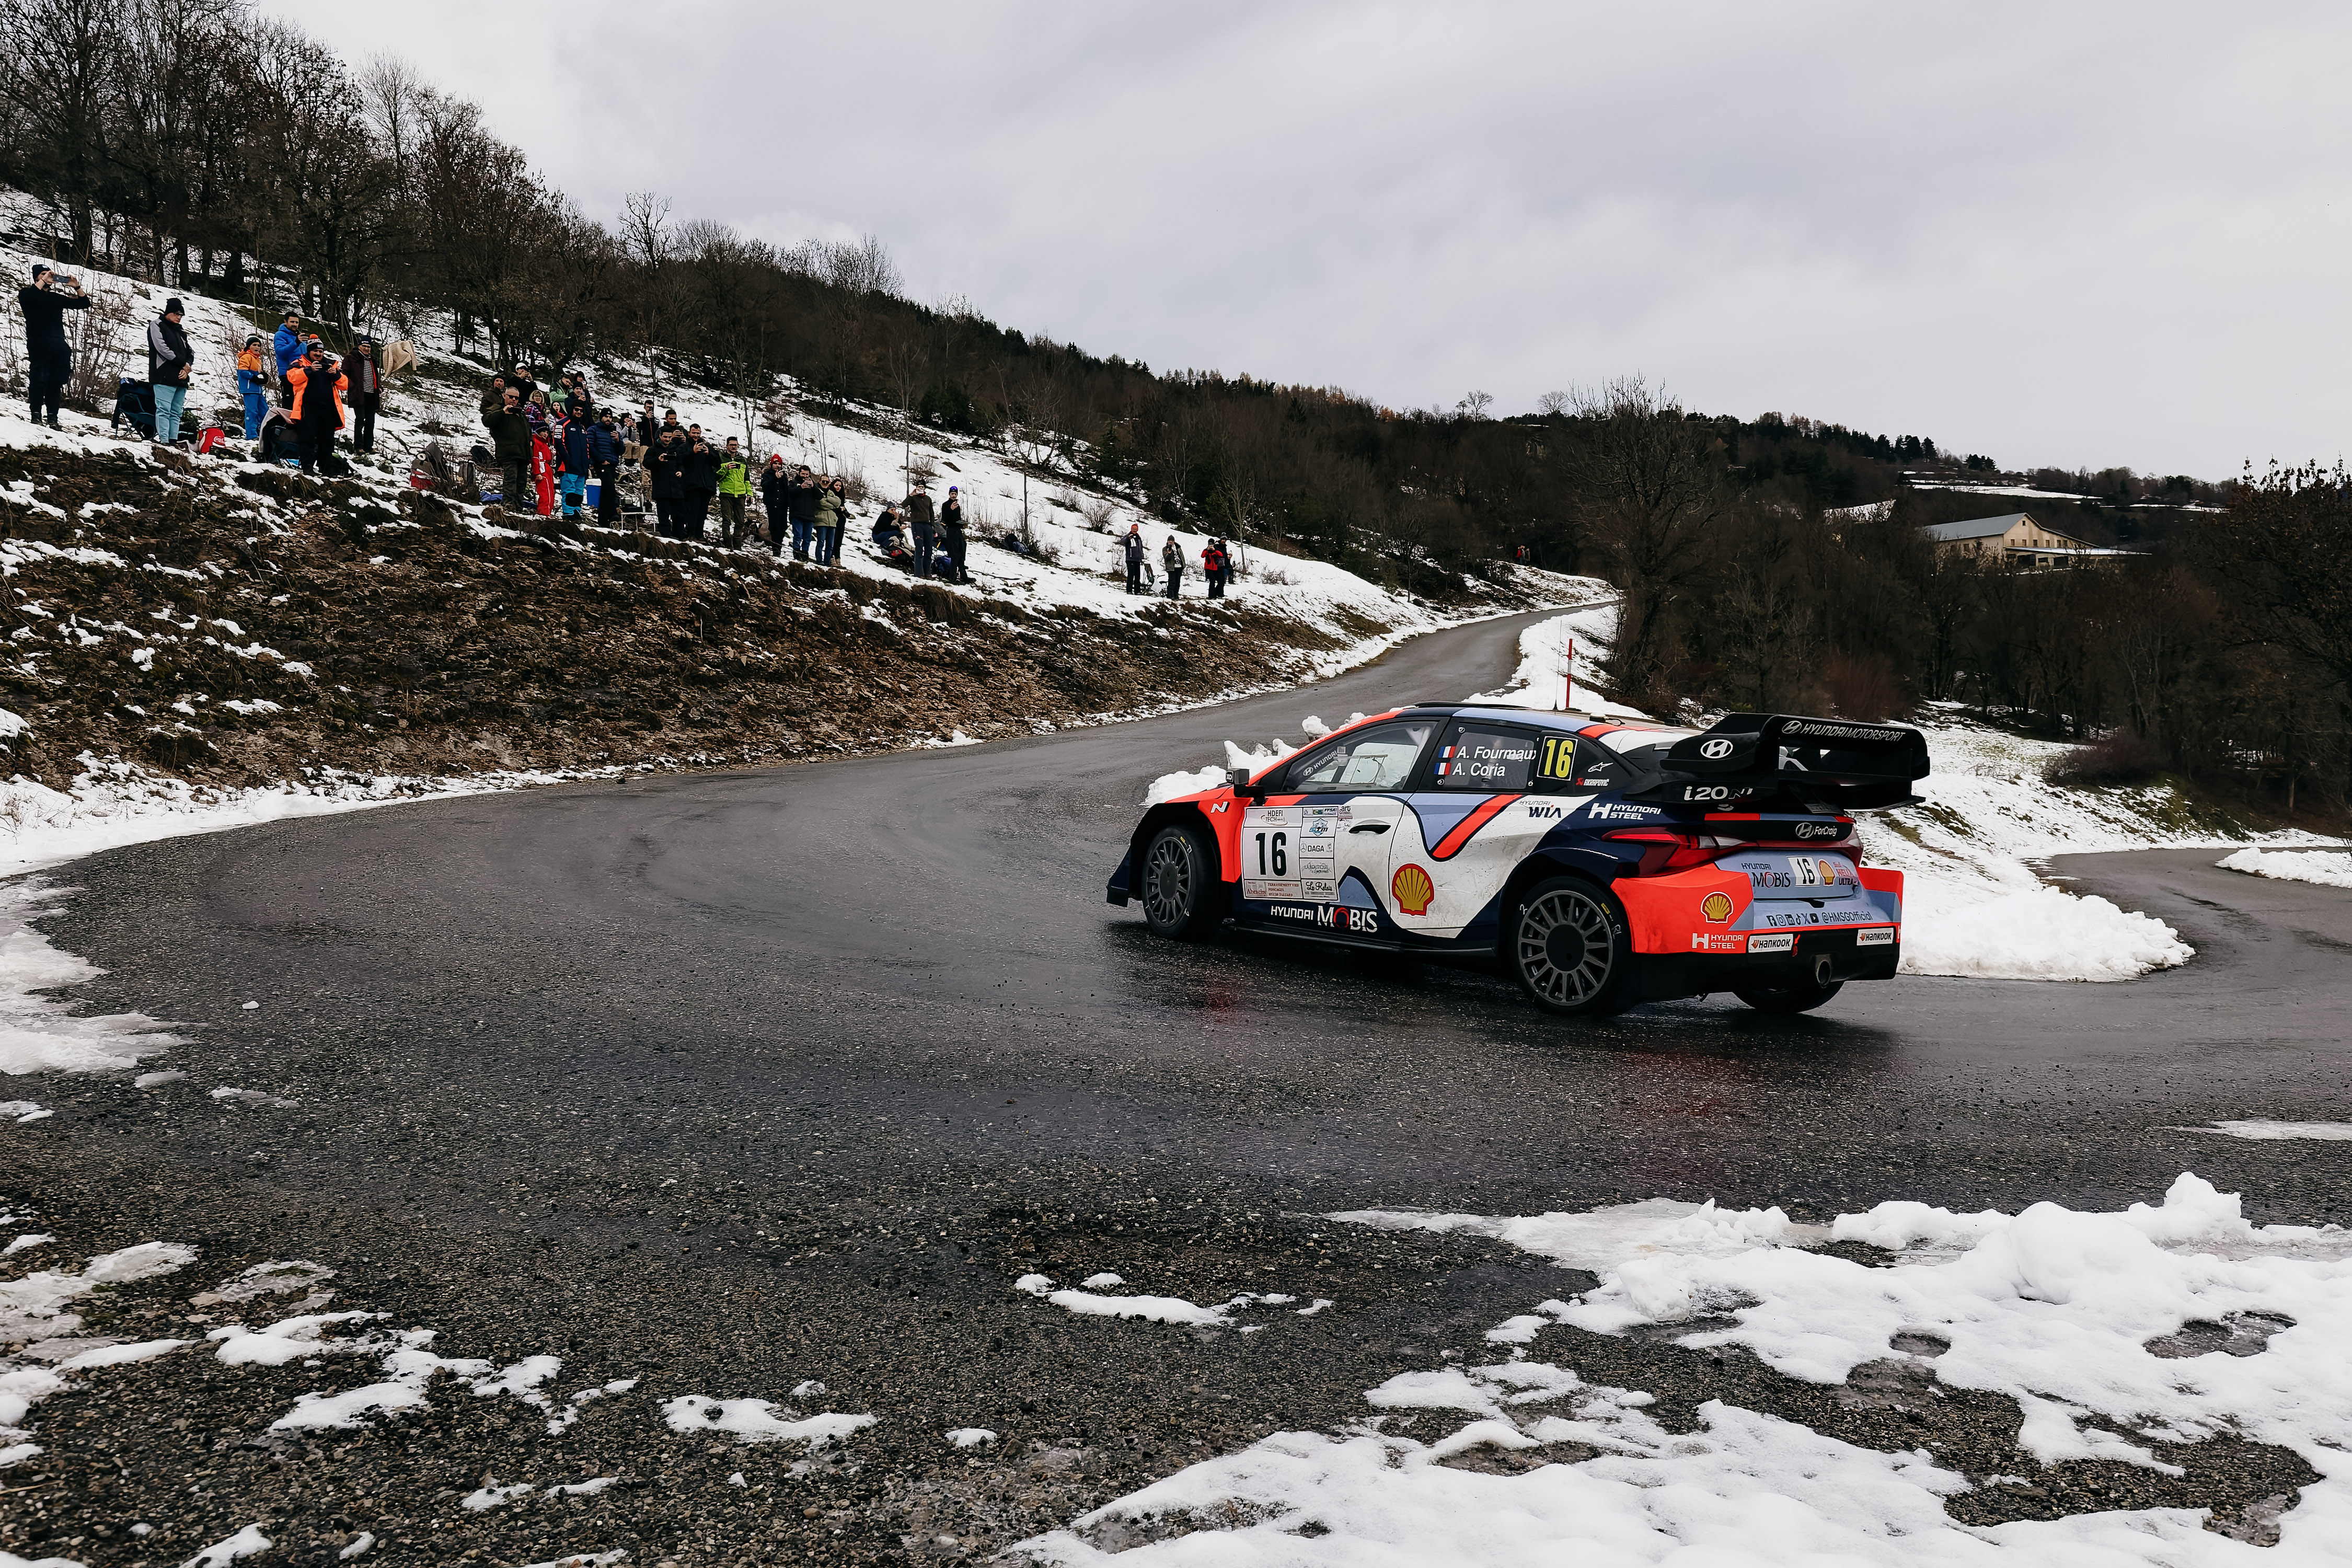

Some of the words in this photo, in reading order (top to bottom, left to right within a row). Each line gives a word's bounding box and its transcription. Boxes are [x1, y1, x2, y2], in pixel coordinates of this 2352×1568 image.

[1313, 750, 1338, 769] HYUNDAI
[1456, 746, 1469, 758] A.
[1474, 747, 1537, 762] Fourmaux
[1543, 740, 1573, 778] 16
[1452, 763, 1465, 776] A.
[1470, 763, 1505, 777] Coria
[1529, 805, 1561, 818] WIA
[1609, 812, 1644, 820] STEEL
[1613, 804, 1662, 815] HYUNDAI
[1255, 832, 1287, 877] 16
[1751, 871, 1791, 887] MOBIS
[1797, 858, 1815, 884] 16
[1271, 906, 1313, 920] HYUNDAI
[1318, 905, 1378, 933] MOBIS
